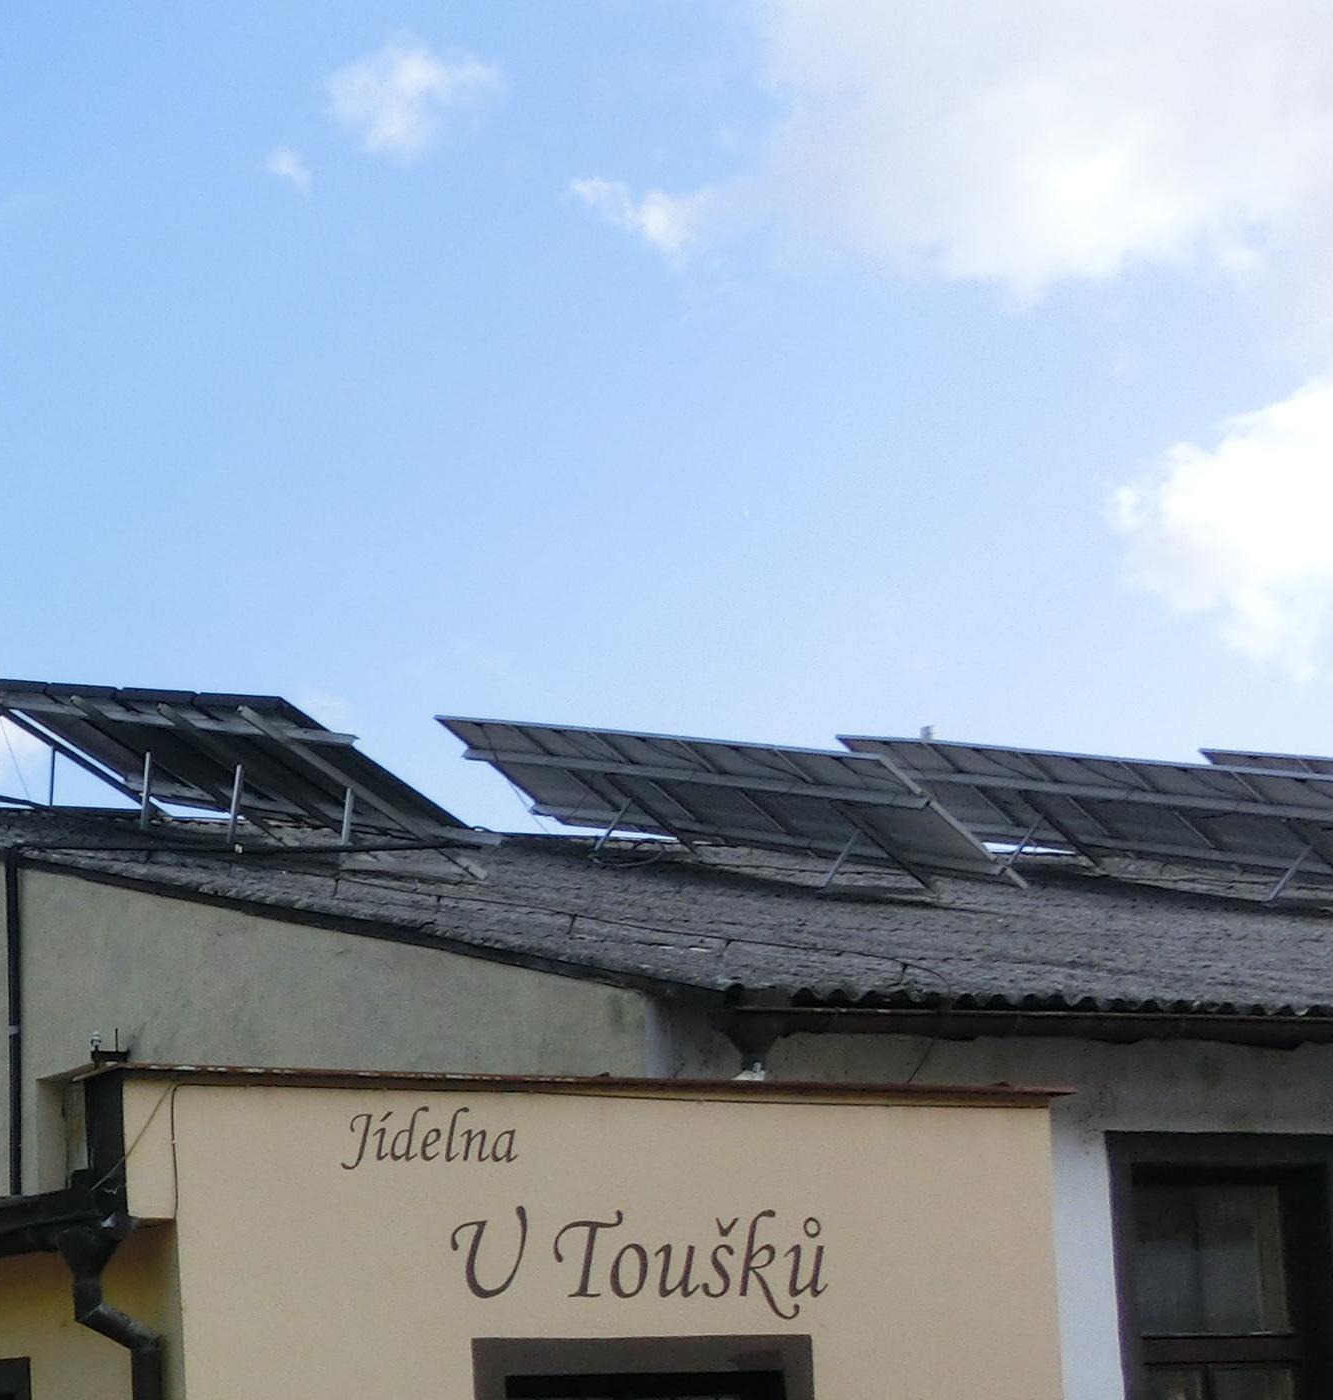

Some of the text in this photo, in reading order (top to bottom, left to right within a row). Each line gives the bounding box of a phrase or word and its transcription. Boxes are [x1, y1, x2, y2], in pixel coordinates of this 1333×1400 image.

[340, 1105, 520, 1171] Jídelna
[450, 1204, 829, 1321] U Toušků
